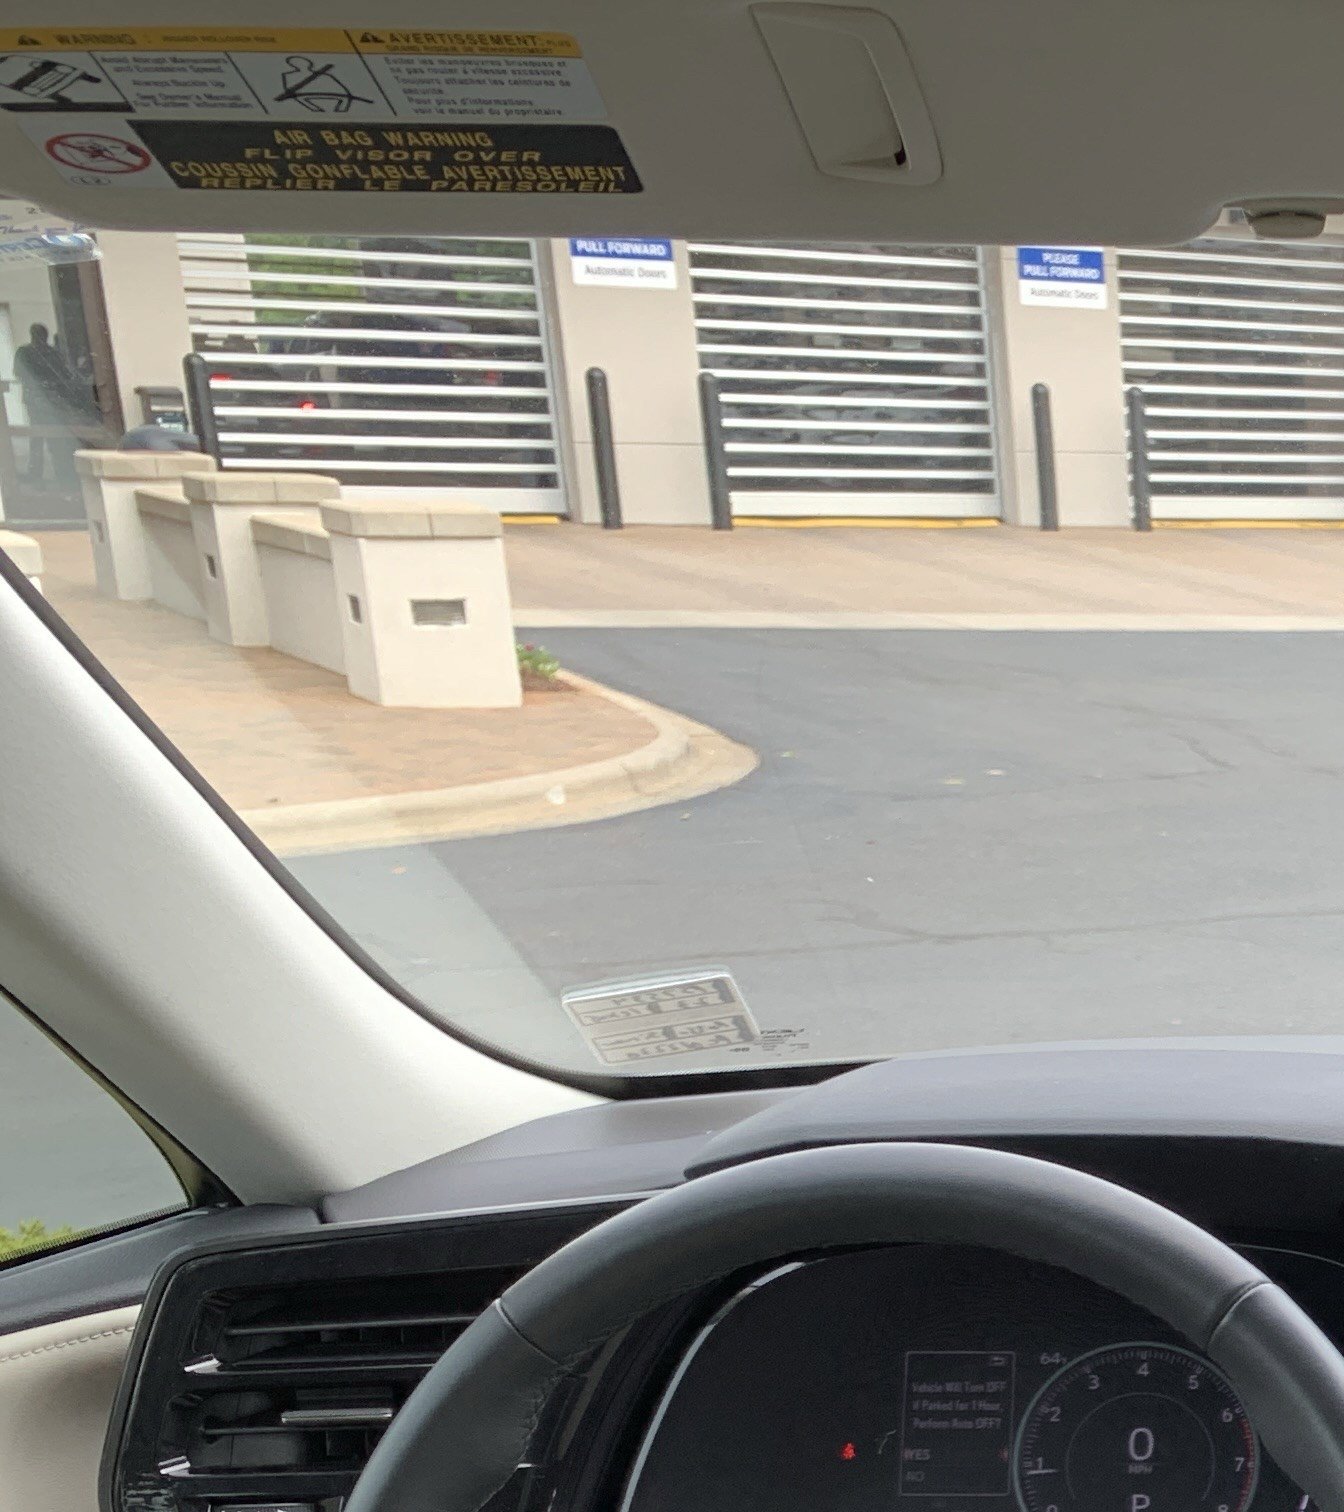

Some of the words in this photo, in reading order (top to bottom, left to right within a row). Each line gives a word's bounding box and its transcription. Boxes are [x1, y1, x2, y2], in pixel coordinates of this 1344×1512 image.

[273, 130, 313, 145] AIR
[320, 130, 373, 147] BAG
[381, 131, 493, 147] WARNING
[245, 148, 314, 160] FLIP
[335, 149, 433, 162] VISOR
[453, 150, 542, 162] OVER
[169, 161, 280, 178] COUSSIN
[288, 162, 432, 181] GONFLABLE
[442, 164, 627, 182] AVERTISSEMENT
[200, 177, 336, 190] REPLIER
[364, 179, 402, 191] LE
[430, 180, 623, 192] PARESOLEIL
[606, 241, 667, 257] FORWARD
[1137, 1363, 1150, 1378] 4
[1088, 1374, 1100, 1391] 3
[1188, 1375, 1199, 1390] 5
[1051, 1406, 1062, 1422] 2
[1222, 1408, 1233, 1423] 6
[1128, 1427, 1155, 1462] 0
[1235, 1457, 1245, 1472] 7
